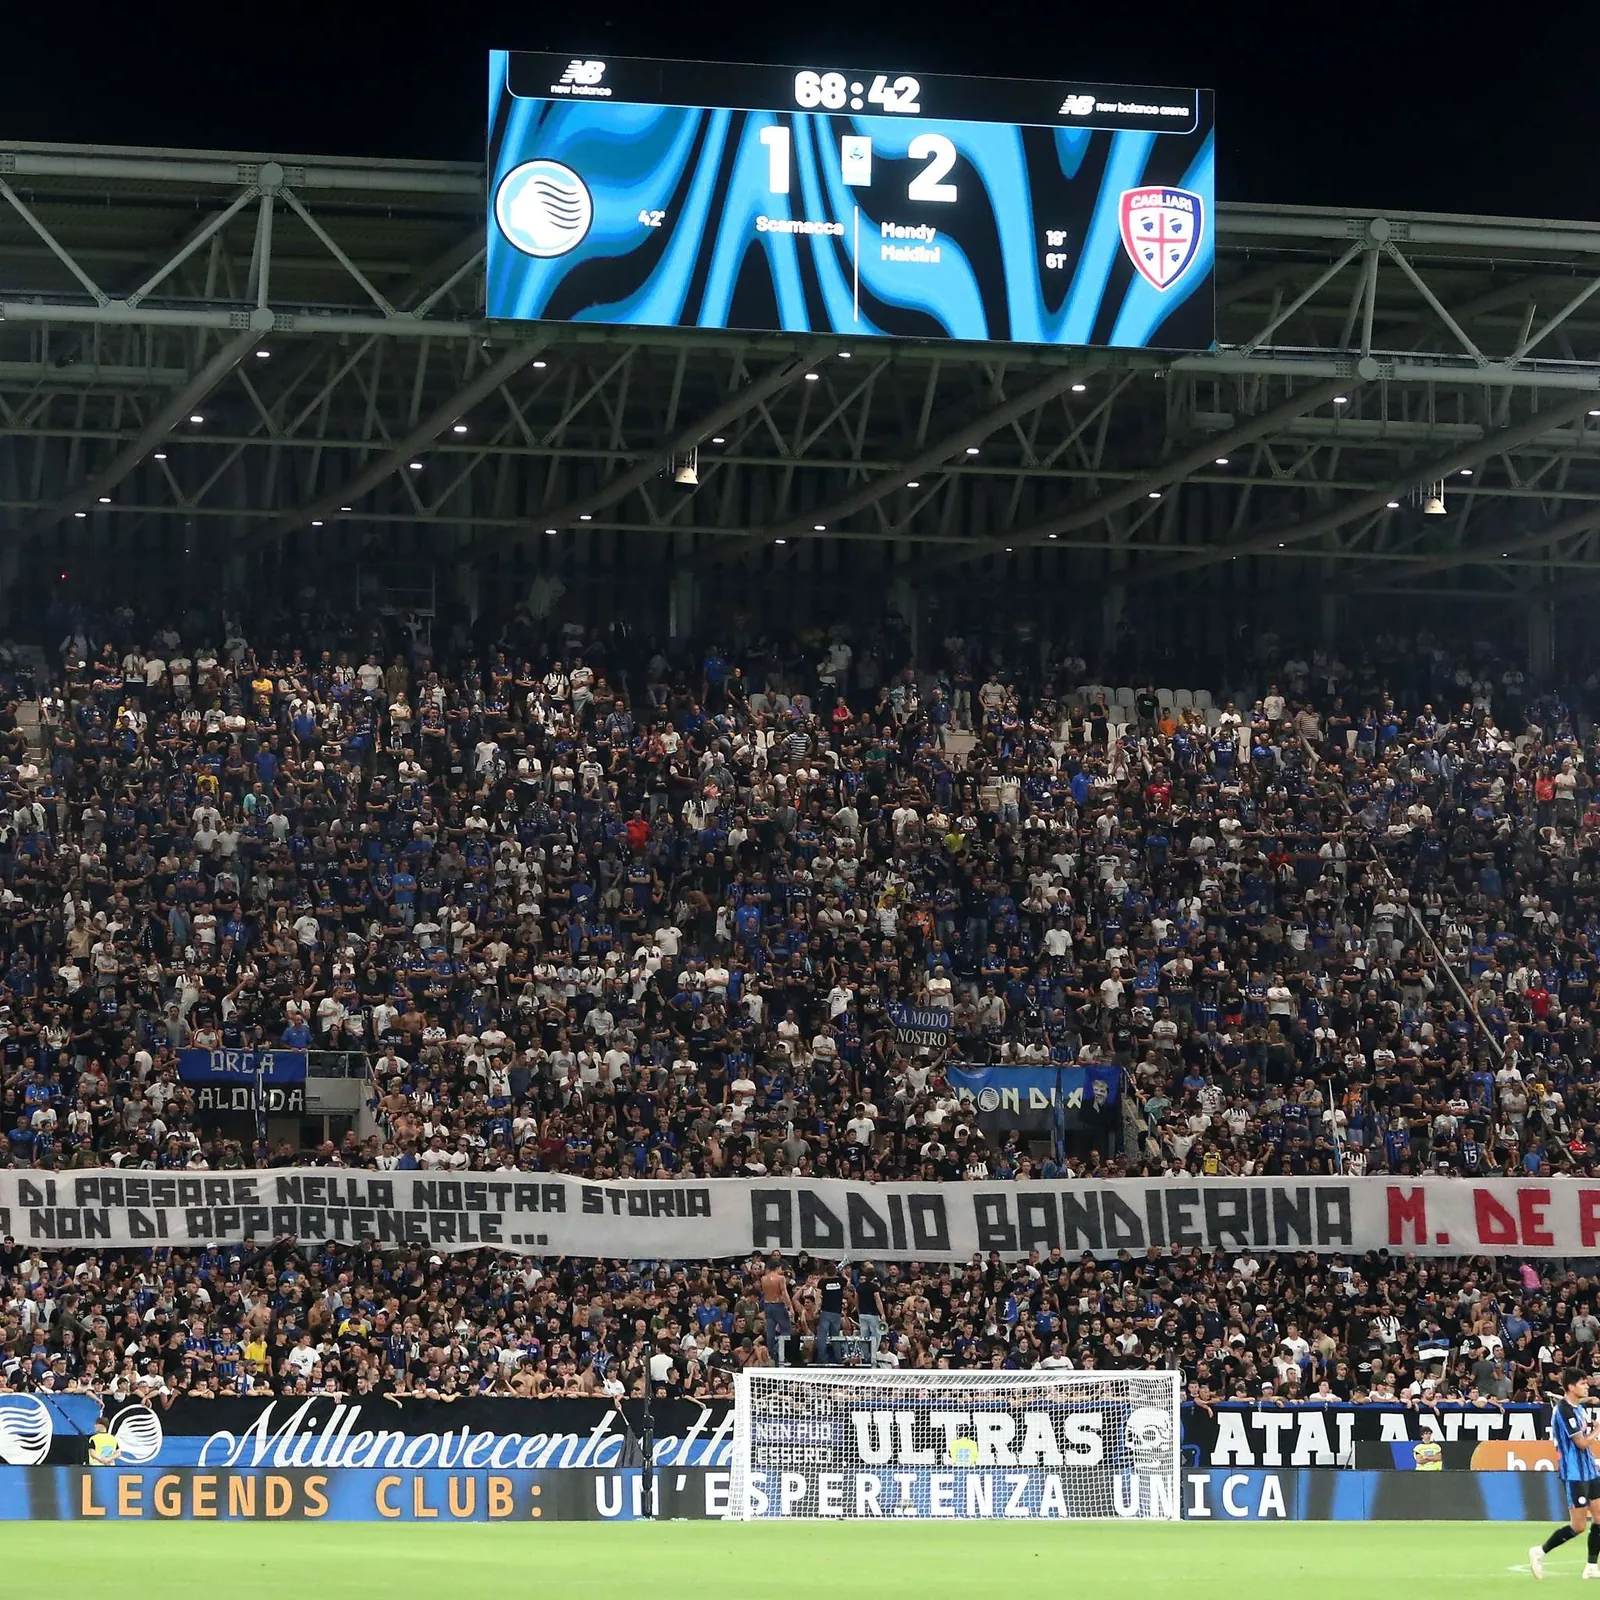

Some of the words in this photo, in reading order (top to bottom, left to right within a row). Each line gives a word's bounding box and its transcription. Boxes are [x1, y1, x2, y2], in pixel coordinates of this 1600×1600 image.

[550, 85, 571, 94] new
[571, 84, 612, 97] balance
[794, 70, 920, 113] 68:42
[1096, 102, 1118, 112] new
[1117, 101, 1159, 115] balance
[760, 126, 790, 194] 1
[907, 133, 958, 203] 2
[1130, 193, 1194, 213] CAGLIARI
[756, 215, 845, 236] Scamacca
[881, 222, 937, 244] Mendy
[881, 245, 941, 264] Maldini
[900, 1009, 908, 1024] A
[910, 1010, 949, 1028] MODO
[895, 1028, 947, 1047] NOSTRO
[210, 1050, 275, 1075] ORCA
[18, 1178, 57, 1207] DI
[75, 1177, 260, 1207] PASSARE
[412, 1180, 567, 1213] NOSTRA
[582, 1184, 711, 1218] STORIA
[30, 1208, 111, 1240] NON
[129, 1209, 169, 1239] DI
[751, 1189, 951, 1251] ADDIO
[973, 1186, 1352, 1252] BANDIERINA
[1386, 1186, 1450, 1246] M.
[1473, 1188, 1554, 1247] DE
[851, 1411, 1103, 1466] ULTRAS
[81, 1474, 330, 1518] LEGENDS
[375, 1475, 542, 1518] CLUB:
[1113, 1473, 1286, 1518] UNICA
